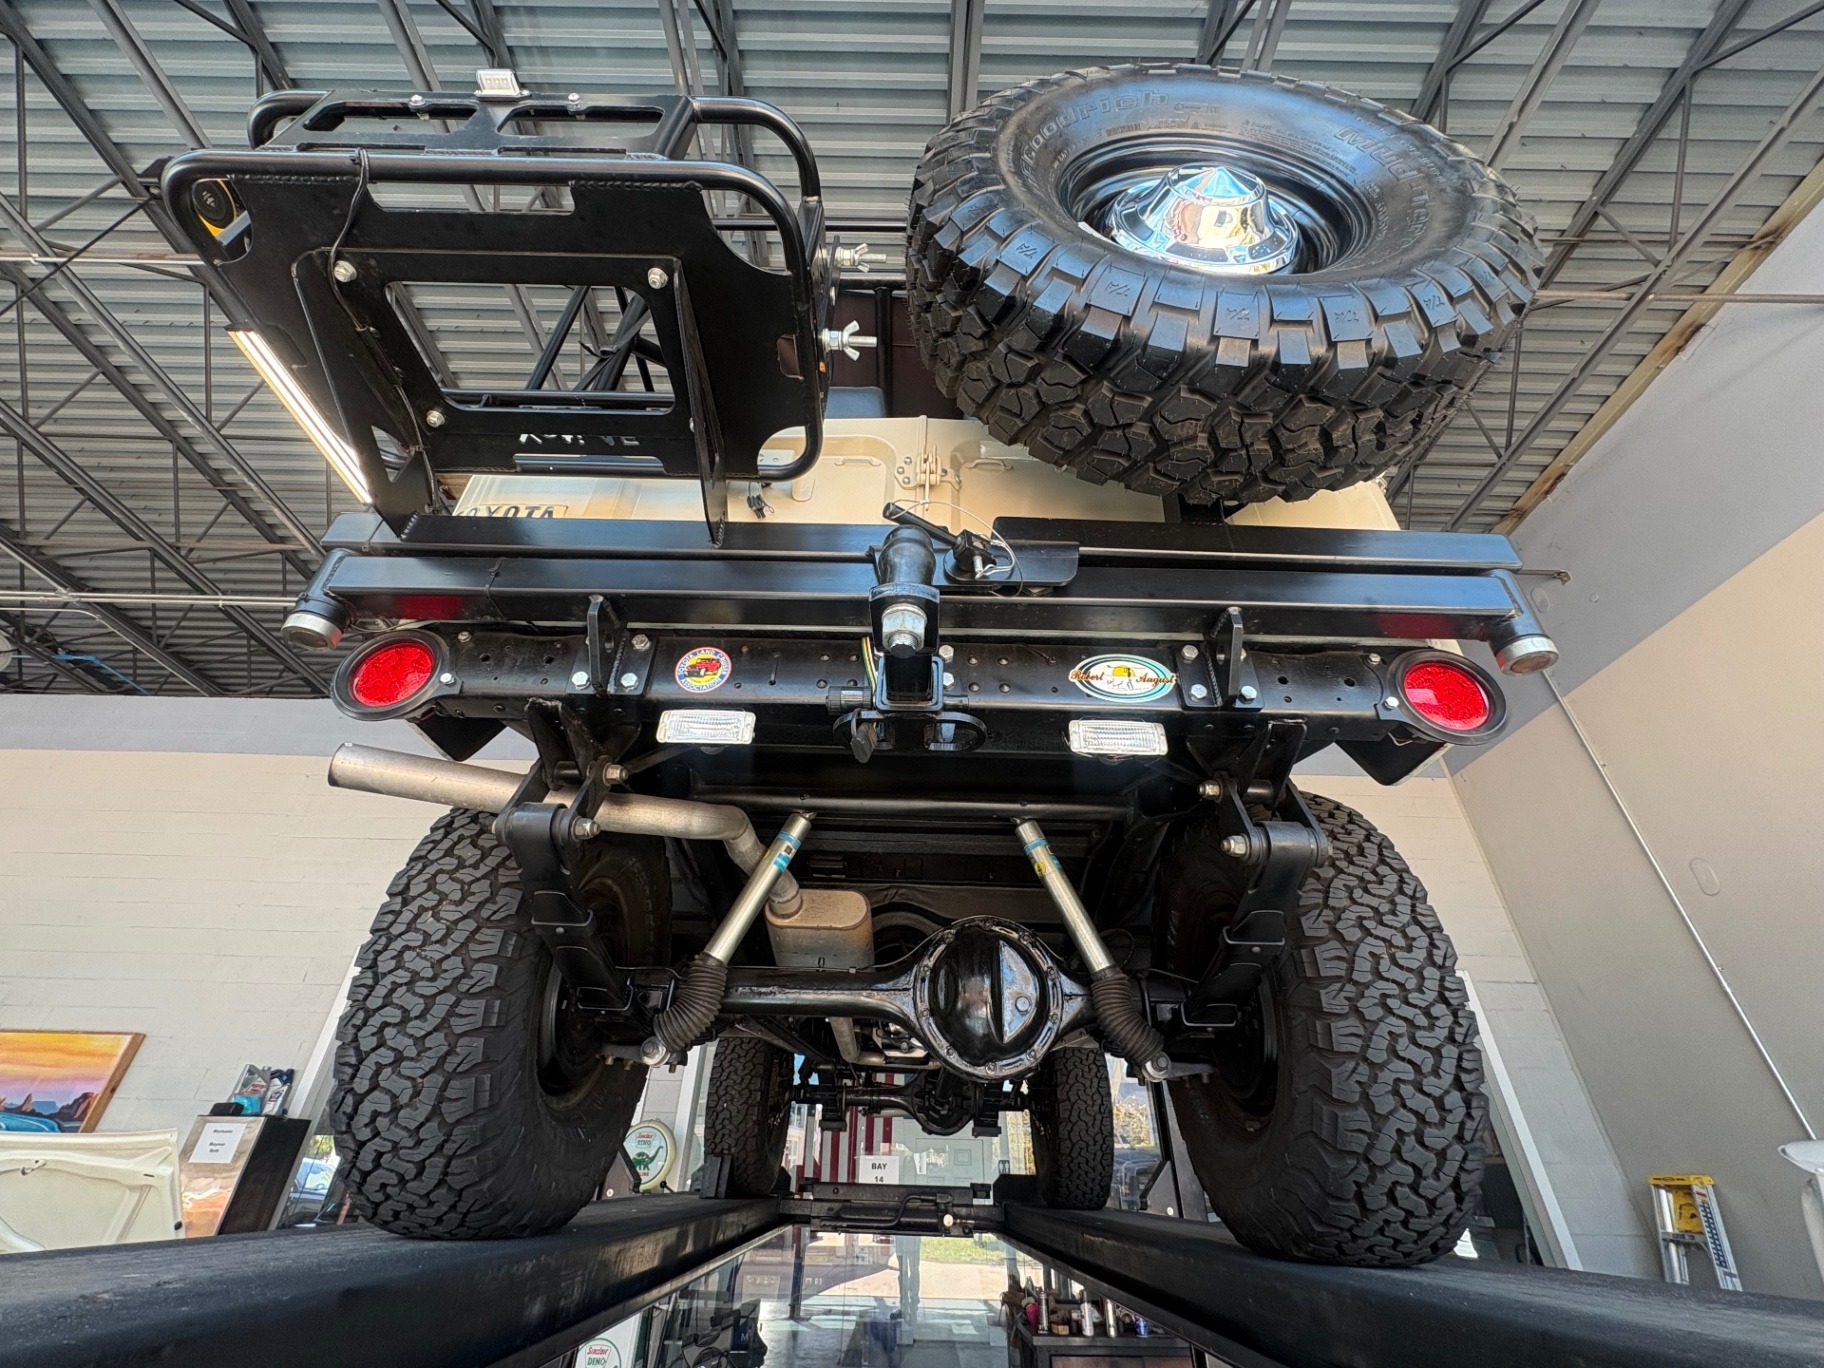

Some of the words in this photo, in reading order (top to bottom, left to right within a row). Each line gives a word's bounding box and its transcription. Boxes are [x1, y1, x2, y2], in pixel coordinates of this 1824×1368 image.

[456, 504, 554, 518] OYOTA
[1069, 669, 1105, 681] Robert
[871, 1162, 888, 1170] BAY
[874, 1175, 885, 1183] 14
